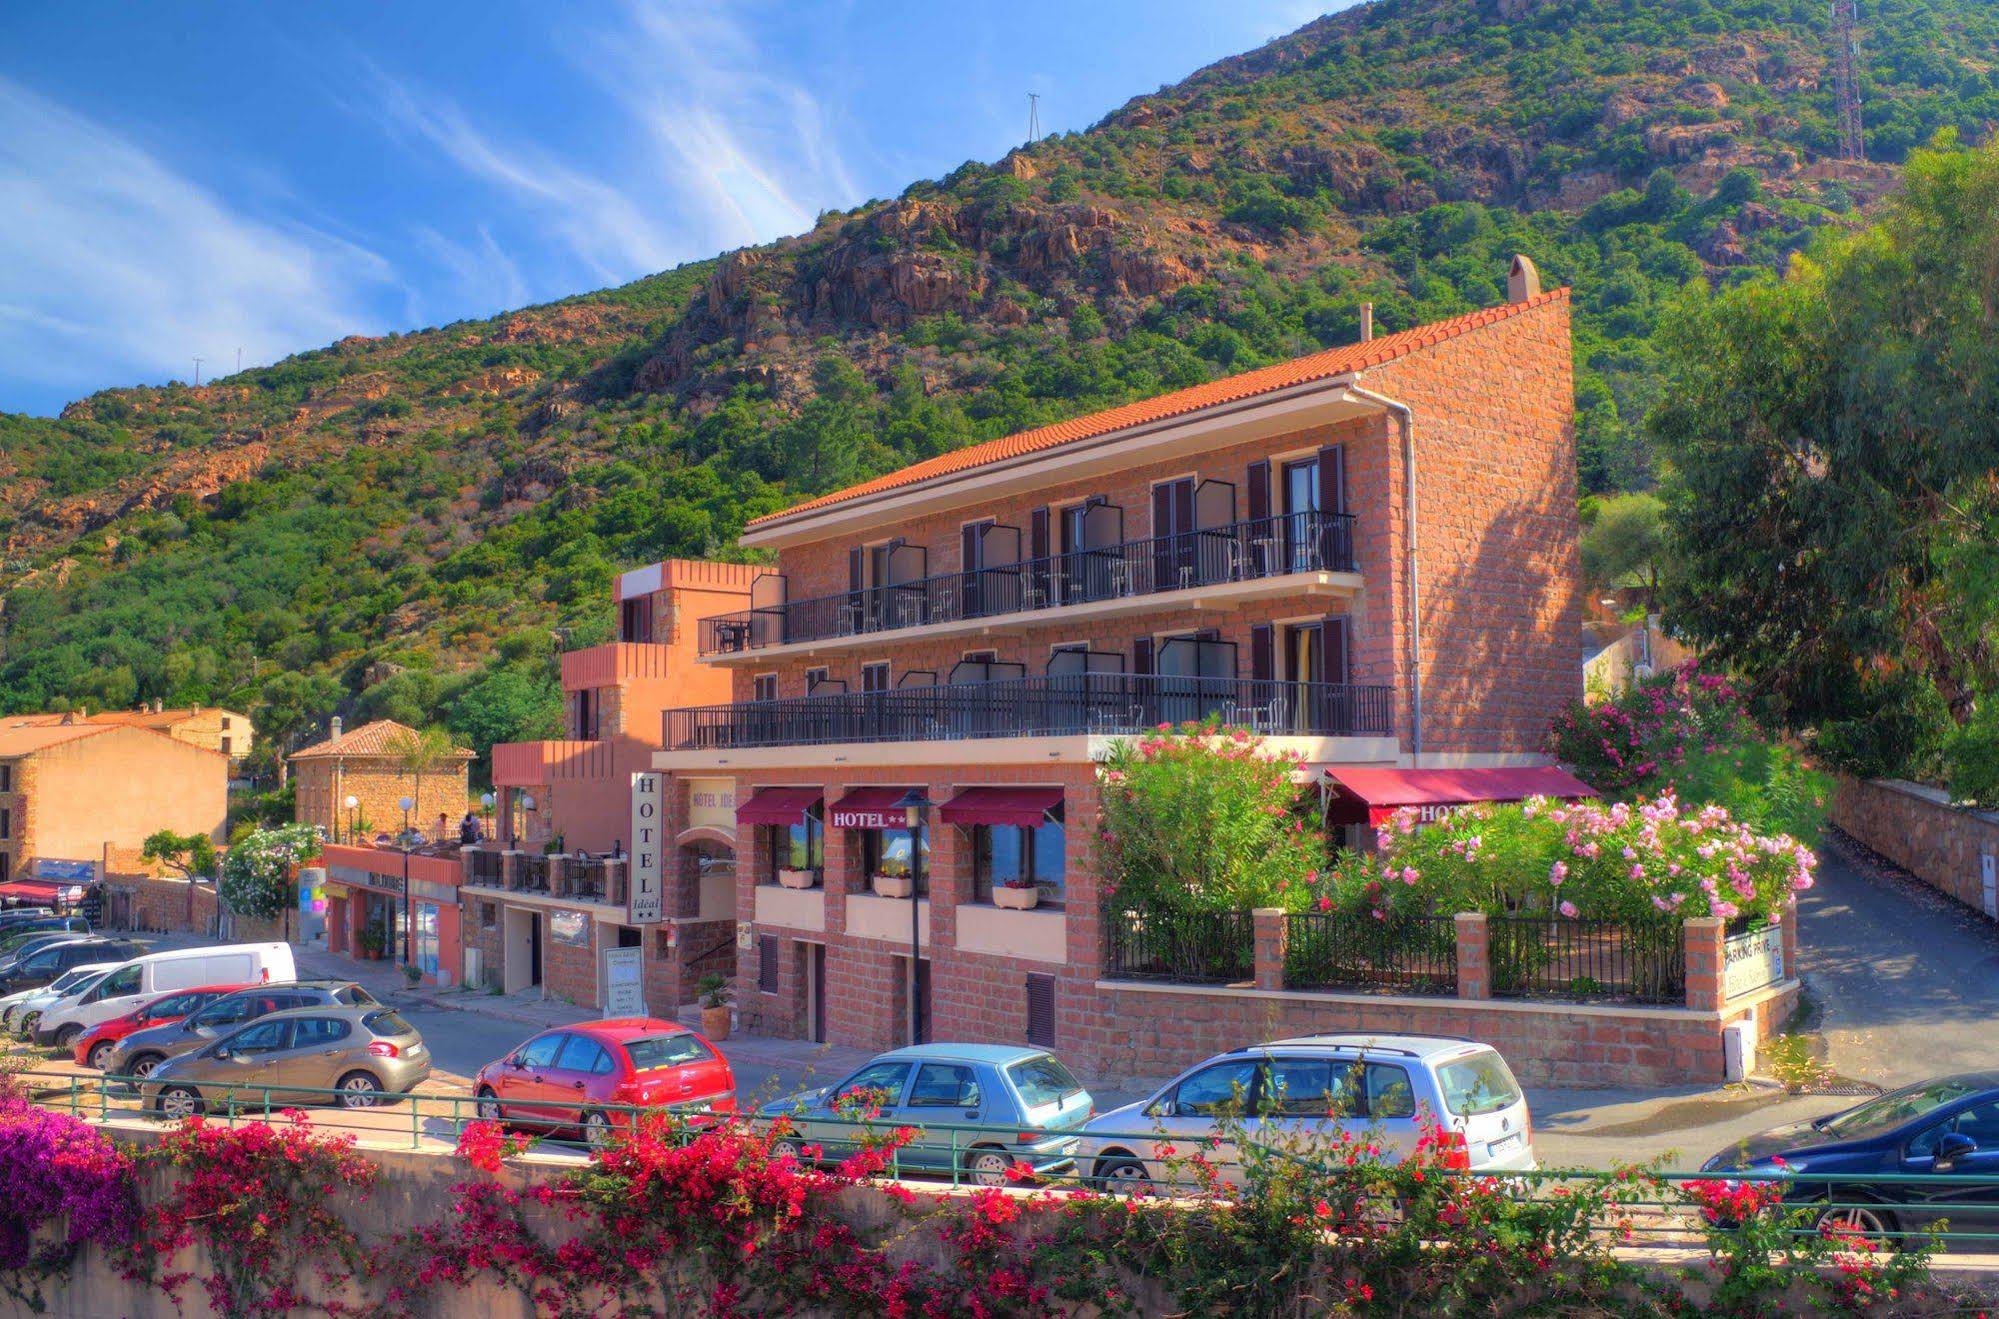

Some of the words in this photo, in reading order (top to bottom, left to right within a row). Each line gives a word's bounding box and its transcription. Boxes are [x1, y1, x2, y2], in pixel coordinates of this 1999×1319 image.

[693, 792, 716, 808] HOTEL
[834, 812, 889, 827] HOTEL
[1420, 804, 1459, 822] HOT
[640, 777, 654, 894] HOTEL
[633, 898, 660, 910] Idéal
